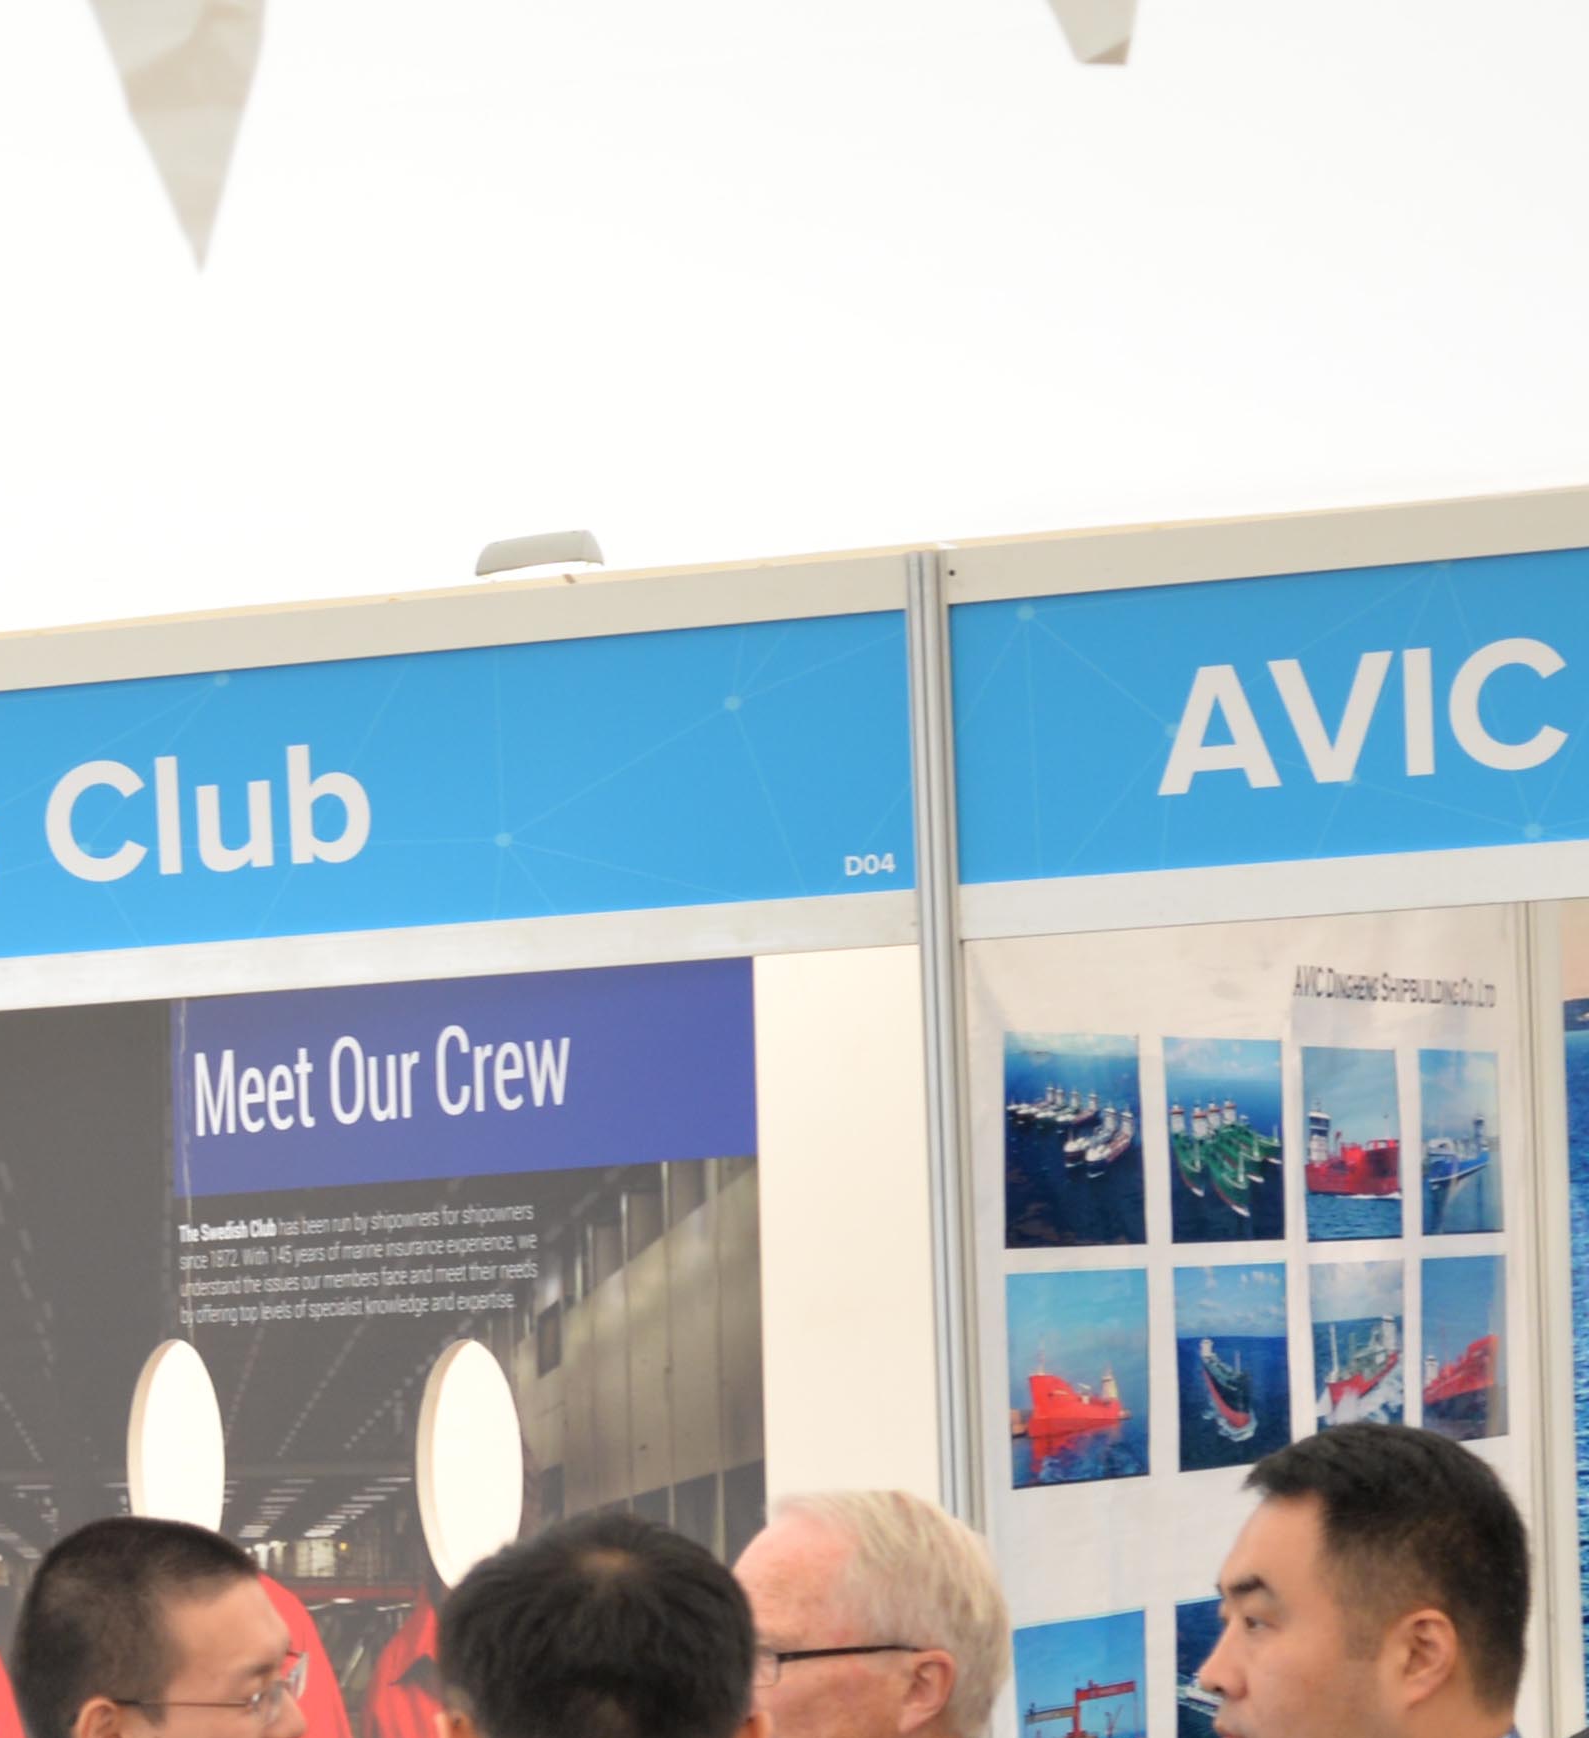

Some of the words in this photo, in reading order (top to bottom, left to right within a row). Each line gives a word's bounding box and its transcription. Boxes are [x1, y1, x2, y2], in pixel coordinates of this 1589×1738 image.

[1158, 638, 1569, 796] AVIC
[45, 744, 371, 882] Club
[845, 853, 896, 876] D04
[1293, 965, 1322, 997] AVIC
[194, 1047, 315, 1137] Meet
[330, 1035, 419, 1125] Our
[435, 1024, 570, 1116] Crew
[178, 1223, 199, 1242] The
[200, 1220, 248, 1241] Swedish
[250, 1218, 277, 1237] Club
[278, 1218, 299, 1236] has
[302, 1216, 330, 1234] been
[332, 1217, 352, 1232] run
[354, 1213, 368, 1235] by
[371, 1210, 440, 1232] shipowners
[442, 1204, 459, 1225] for
[461, 1203, 534, 1227] shipowners
[180, 1251, 209, 1270] since
[242, 1246, 269, 1266] With
[270, 1245, 292, 1264] 145
[293, 1247, 325, 1268] years
[328, 1241, 340, 1261] of
[342, 1240, 383, 1260] marine
[385, 1237, 445, 1258] insurance
[517, 1234, 537, 1249] we
[180, 1276, 241, 1297] understand
[243, 1275, 261, 1294] the
[263, 1273, 299, 1292] issues
[301, 1275, 321, 1290] our
[323, 1268, 379, 1289] members
[381, 1266, 407, 1286] face
[410, 1264, 433, 1284] and
[435, 1265, 466, 1283] meet
[468, 1261, 498, 1281] their
[499, 1259, 538, 1279] needs
[180, 1306, 193, 1327] by
[196, 1304, 238, 1326] offering
[239, 1305, 258, 1324] top
[261, 1301, 292, 1320] levels
[294, 1299, 307, 1318] of
[308, 1297, 363, 1322] specialist
[365, 1293, 429, 1317] knowledge
[431, 1292, 455, 1311] and
